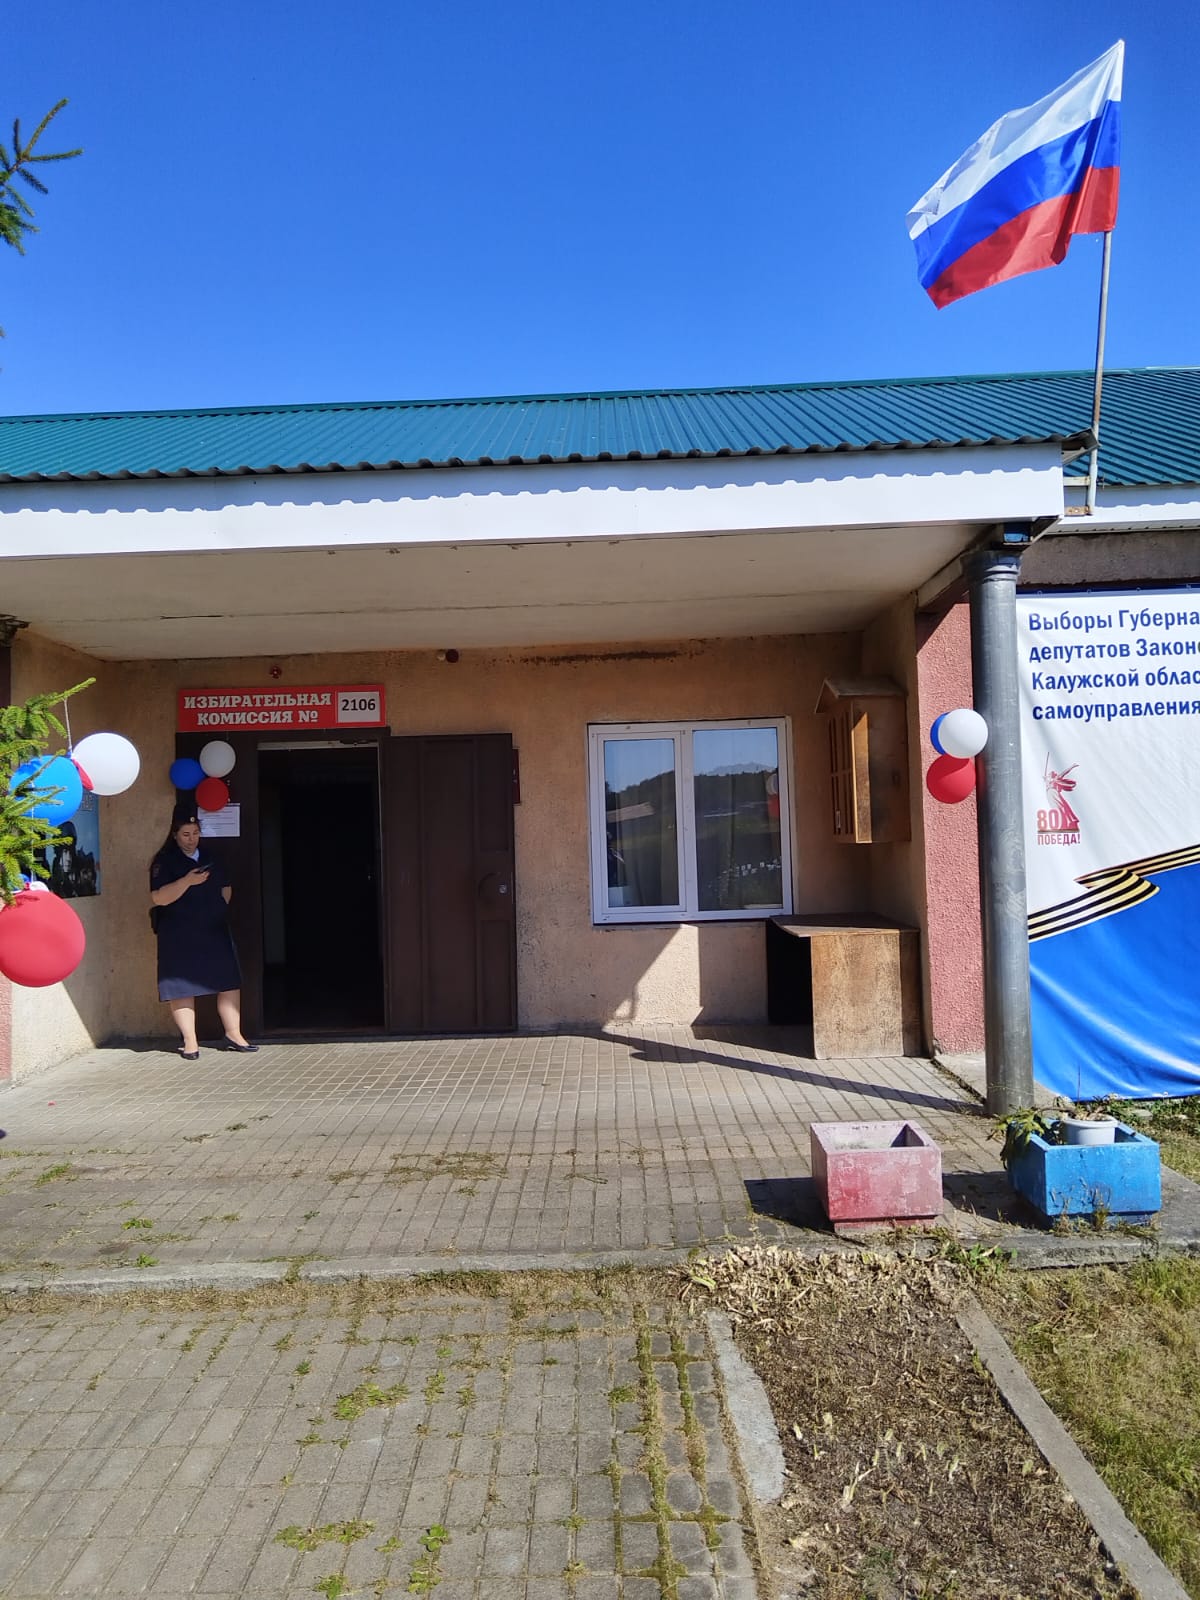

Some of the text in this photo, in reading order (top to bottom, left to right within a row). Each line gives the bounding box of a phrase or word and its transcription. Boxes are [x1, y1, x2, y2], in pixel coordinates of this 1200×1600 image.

[1029, 608, 1200, 633] Выборы Губерна
[1029, 638, 1200, 663] депутатов Закон
[1032, 668, 1139, 693] Калужской
[184, 693, 332, 709] ИЗБИРАТЕЛЬНАЯ
[341, 698, 376, 711] 2106
[1032, 700, 1200, 722] самоуправления
[197, 710, 319, 725] КОМИССИЯ №
[1037, 809, 1059, 830] 80
[1037, 834, 1080, 846] ПОБЕДА!
